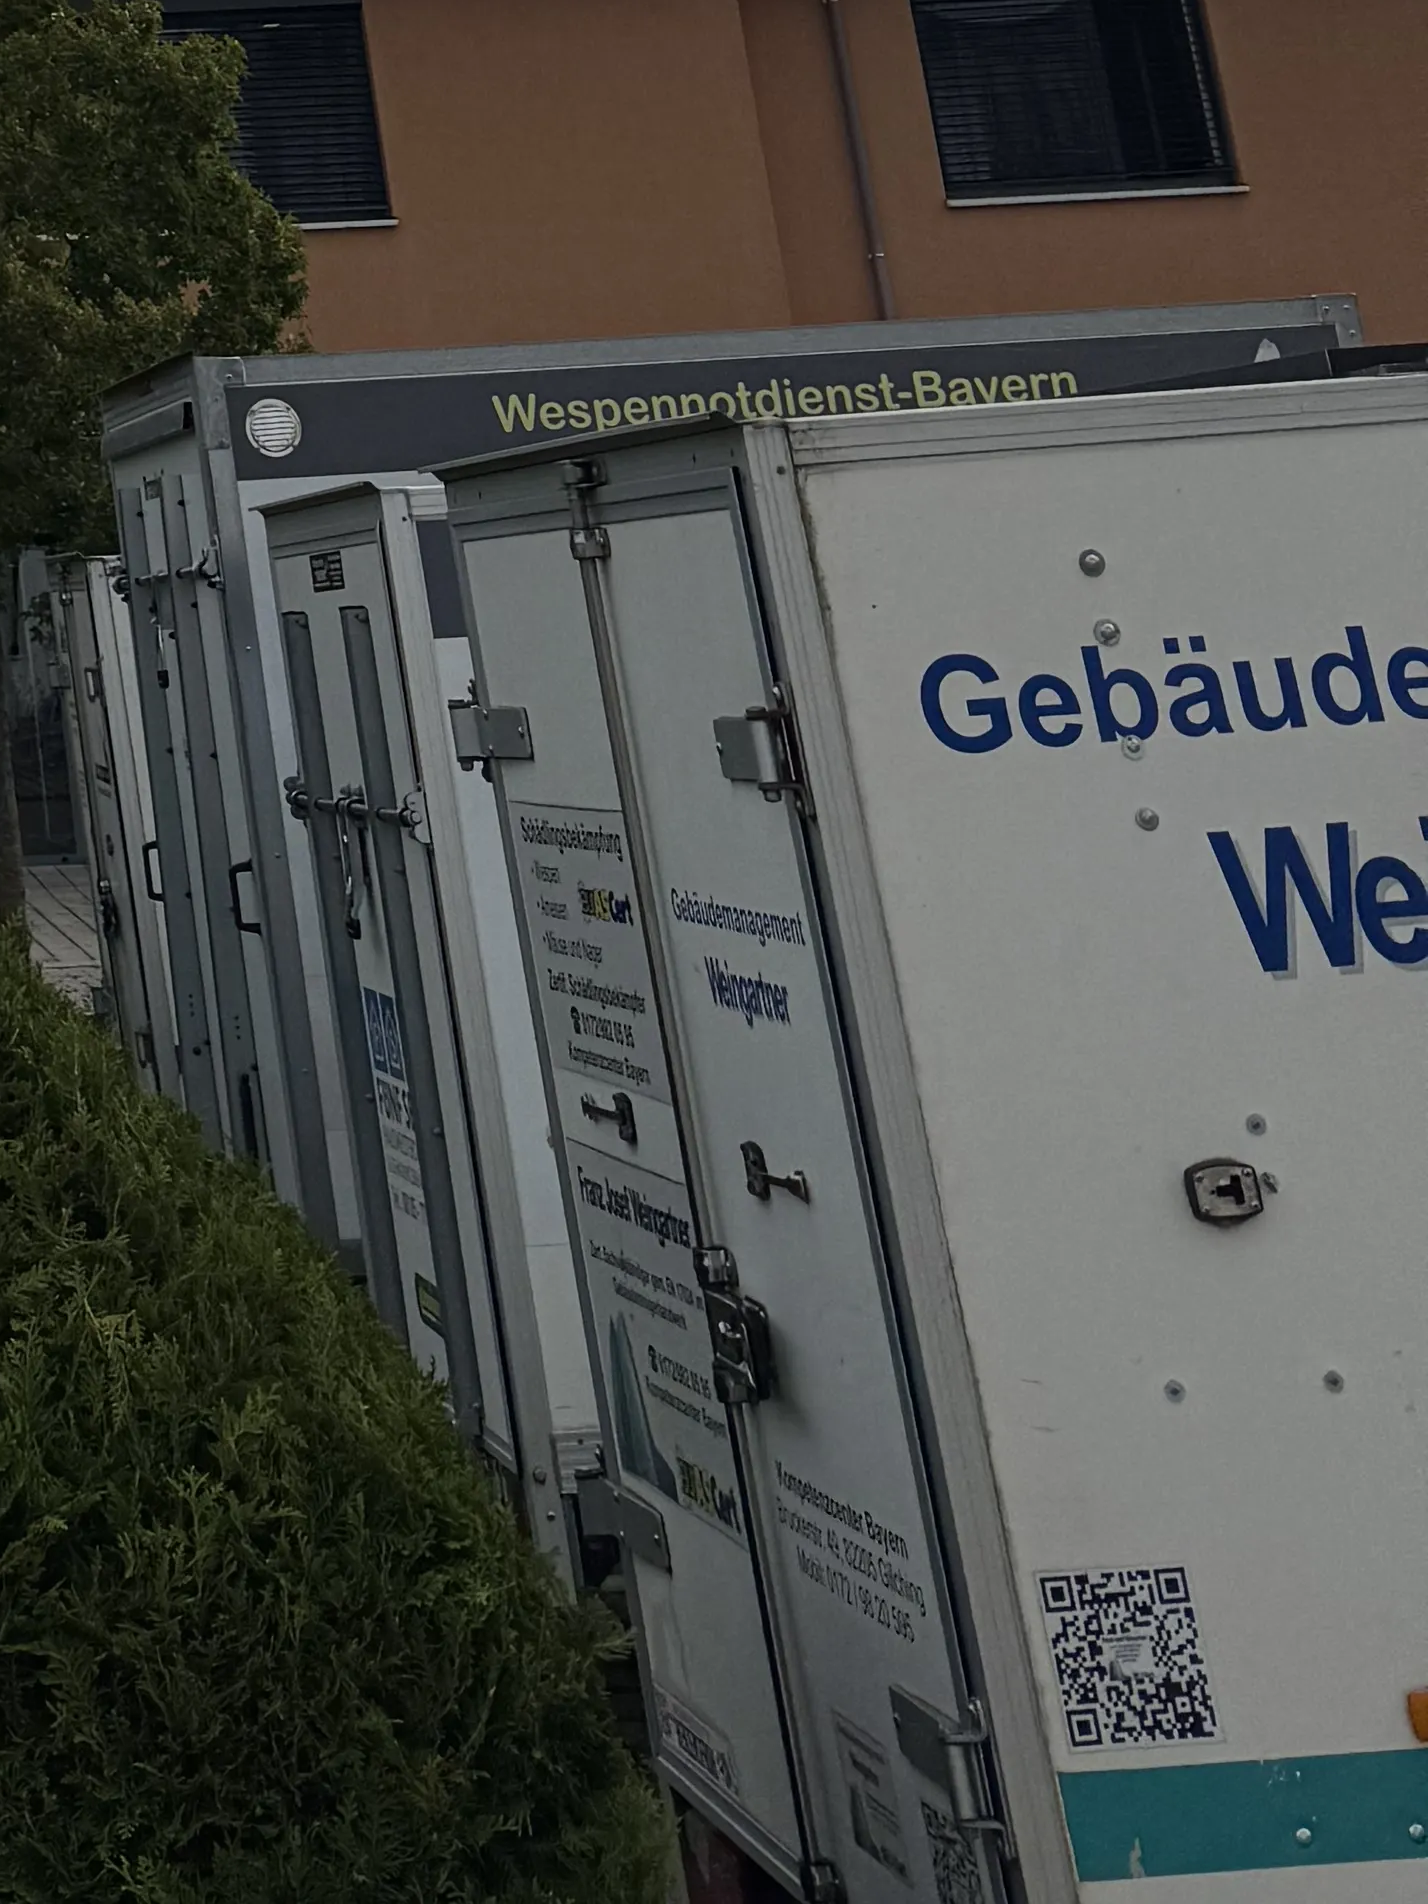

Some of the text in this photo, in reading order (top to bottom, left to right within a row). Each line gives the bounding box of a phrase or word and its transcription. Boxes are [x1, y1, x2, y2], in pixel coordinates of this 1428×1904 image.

[671, 888, 806, 947] Gebäudemanagement
[1206, 815, 1428, 972] We
[704, 956, 791, 1029] Weingartner
[864, 1510, 909, 1561] Bayern
